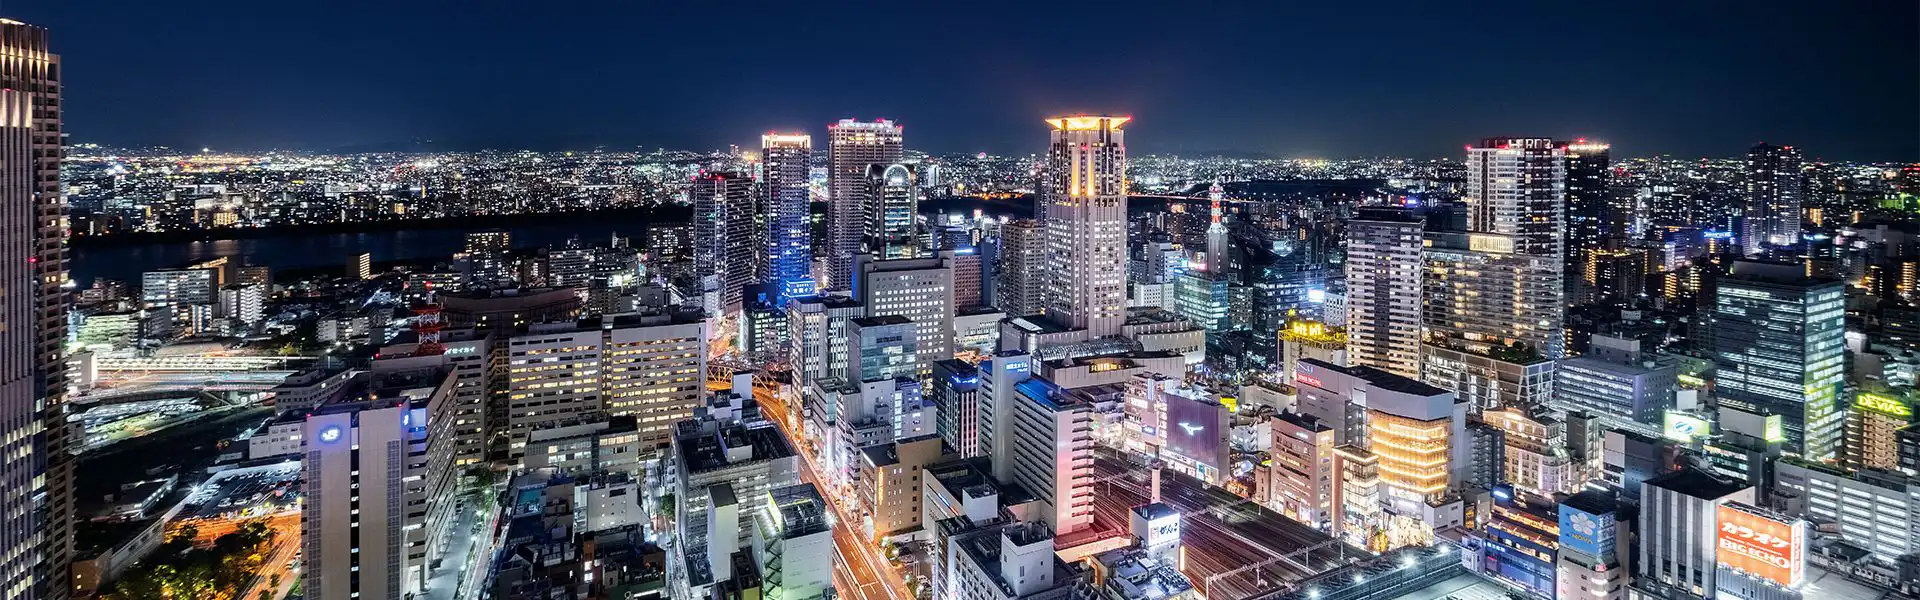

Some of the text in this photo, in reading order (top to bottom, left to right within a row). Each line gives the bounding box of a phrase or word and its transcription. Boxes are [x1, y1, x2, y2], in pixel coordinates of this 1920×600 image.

[444, 346, 476, 355] イセイカイ
[1721, 522, 1790, 548] カラオケ
[1719, 537, 1747, 553] BIG
[1748, 547, 1790, 569] ECHO
